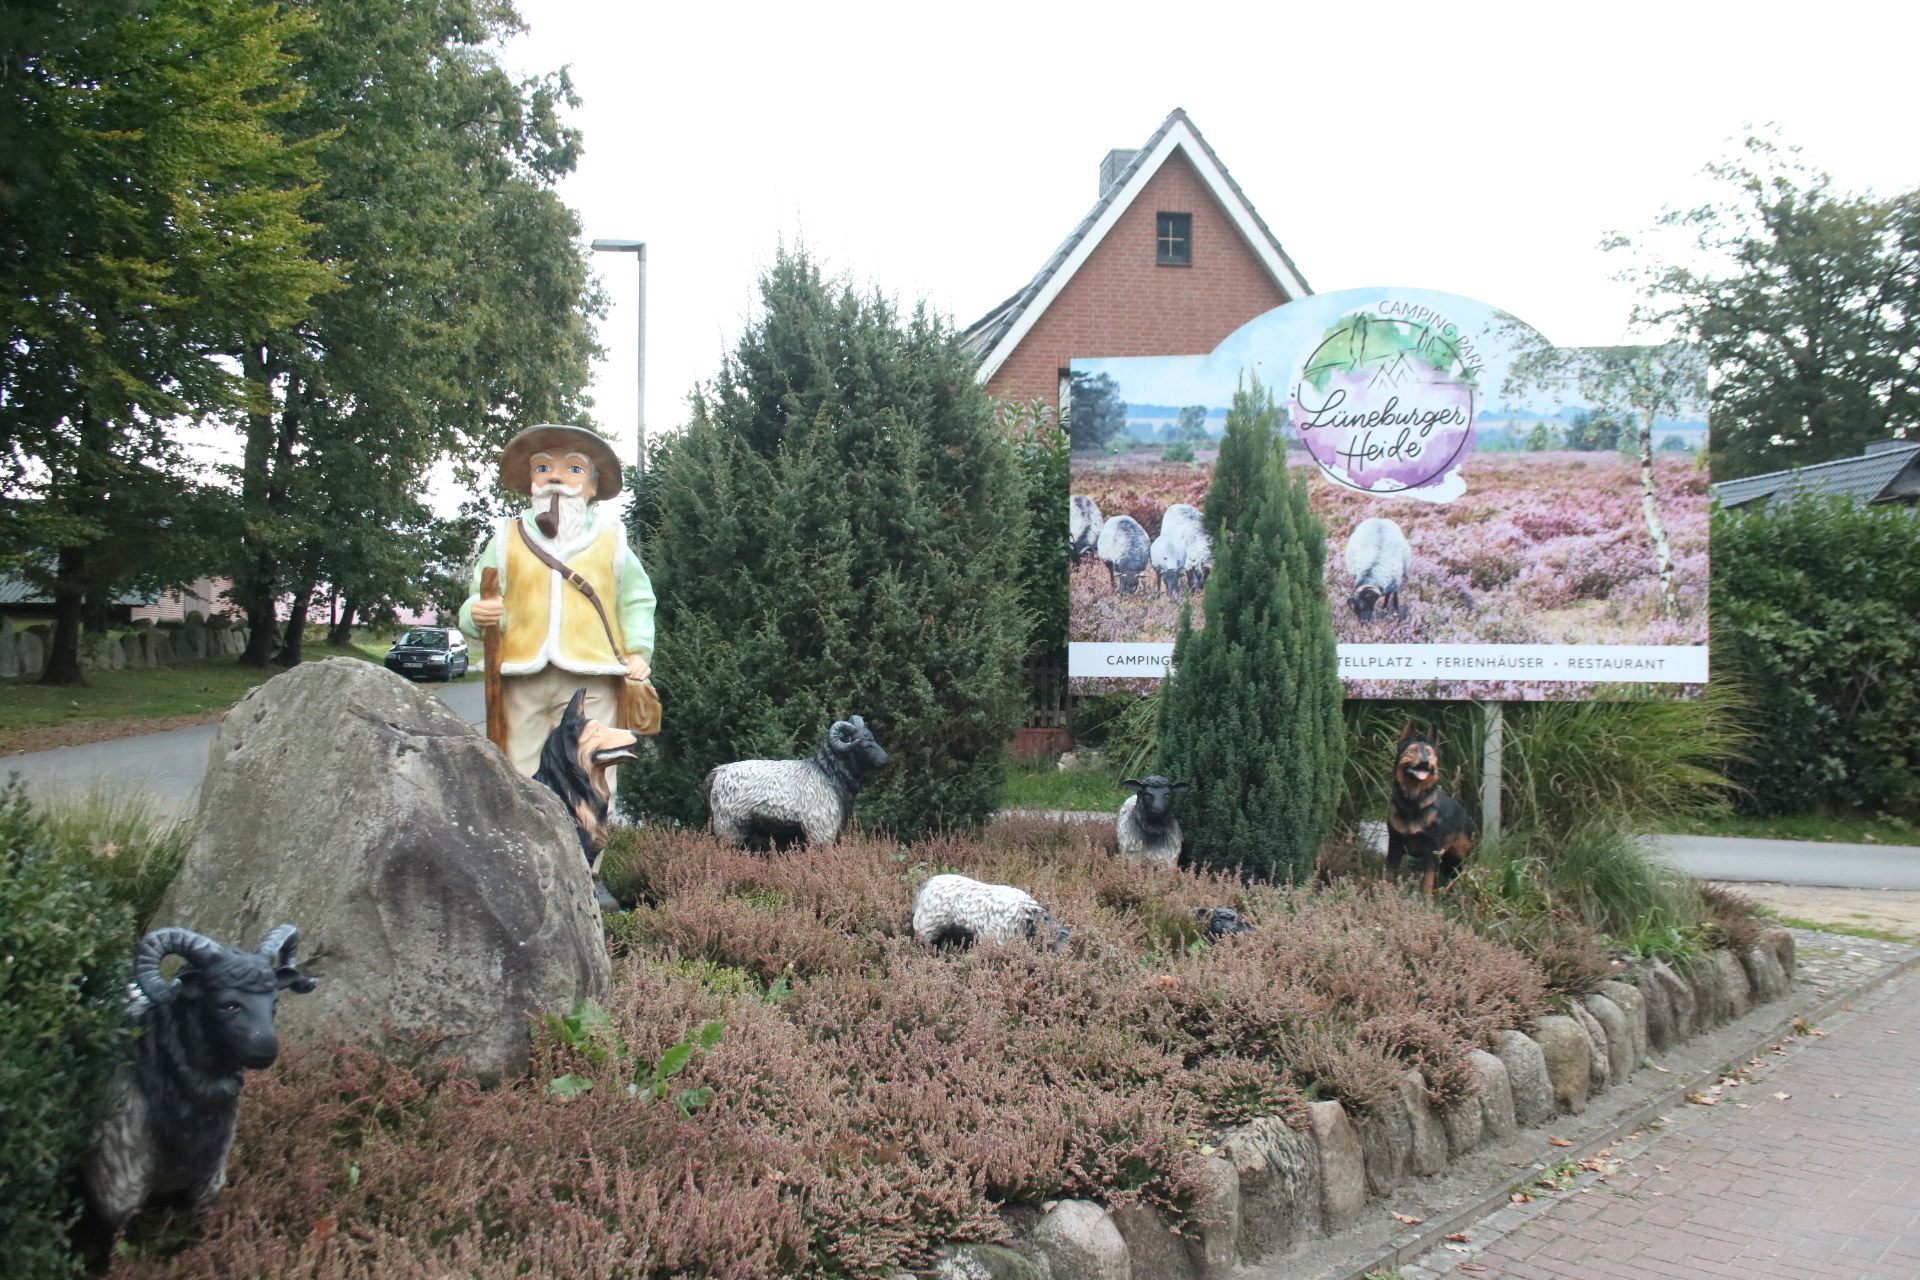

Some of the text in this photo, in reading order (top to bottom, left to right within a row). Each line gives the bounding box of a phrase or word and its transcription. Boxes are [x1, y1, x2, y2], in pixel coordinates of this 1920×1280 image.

[1378, 300, 1488, 377] CAMPING PARK
[1299, 389, 1466, 437] Lüneburger
[1336, 427, 1422, 471] Heide
[1106, 654, 1666, 670] CAMPING TELLPLATZ FERIENHÄUSER RESTAURANT
